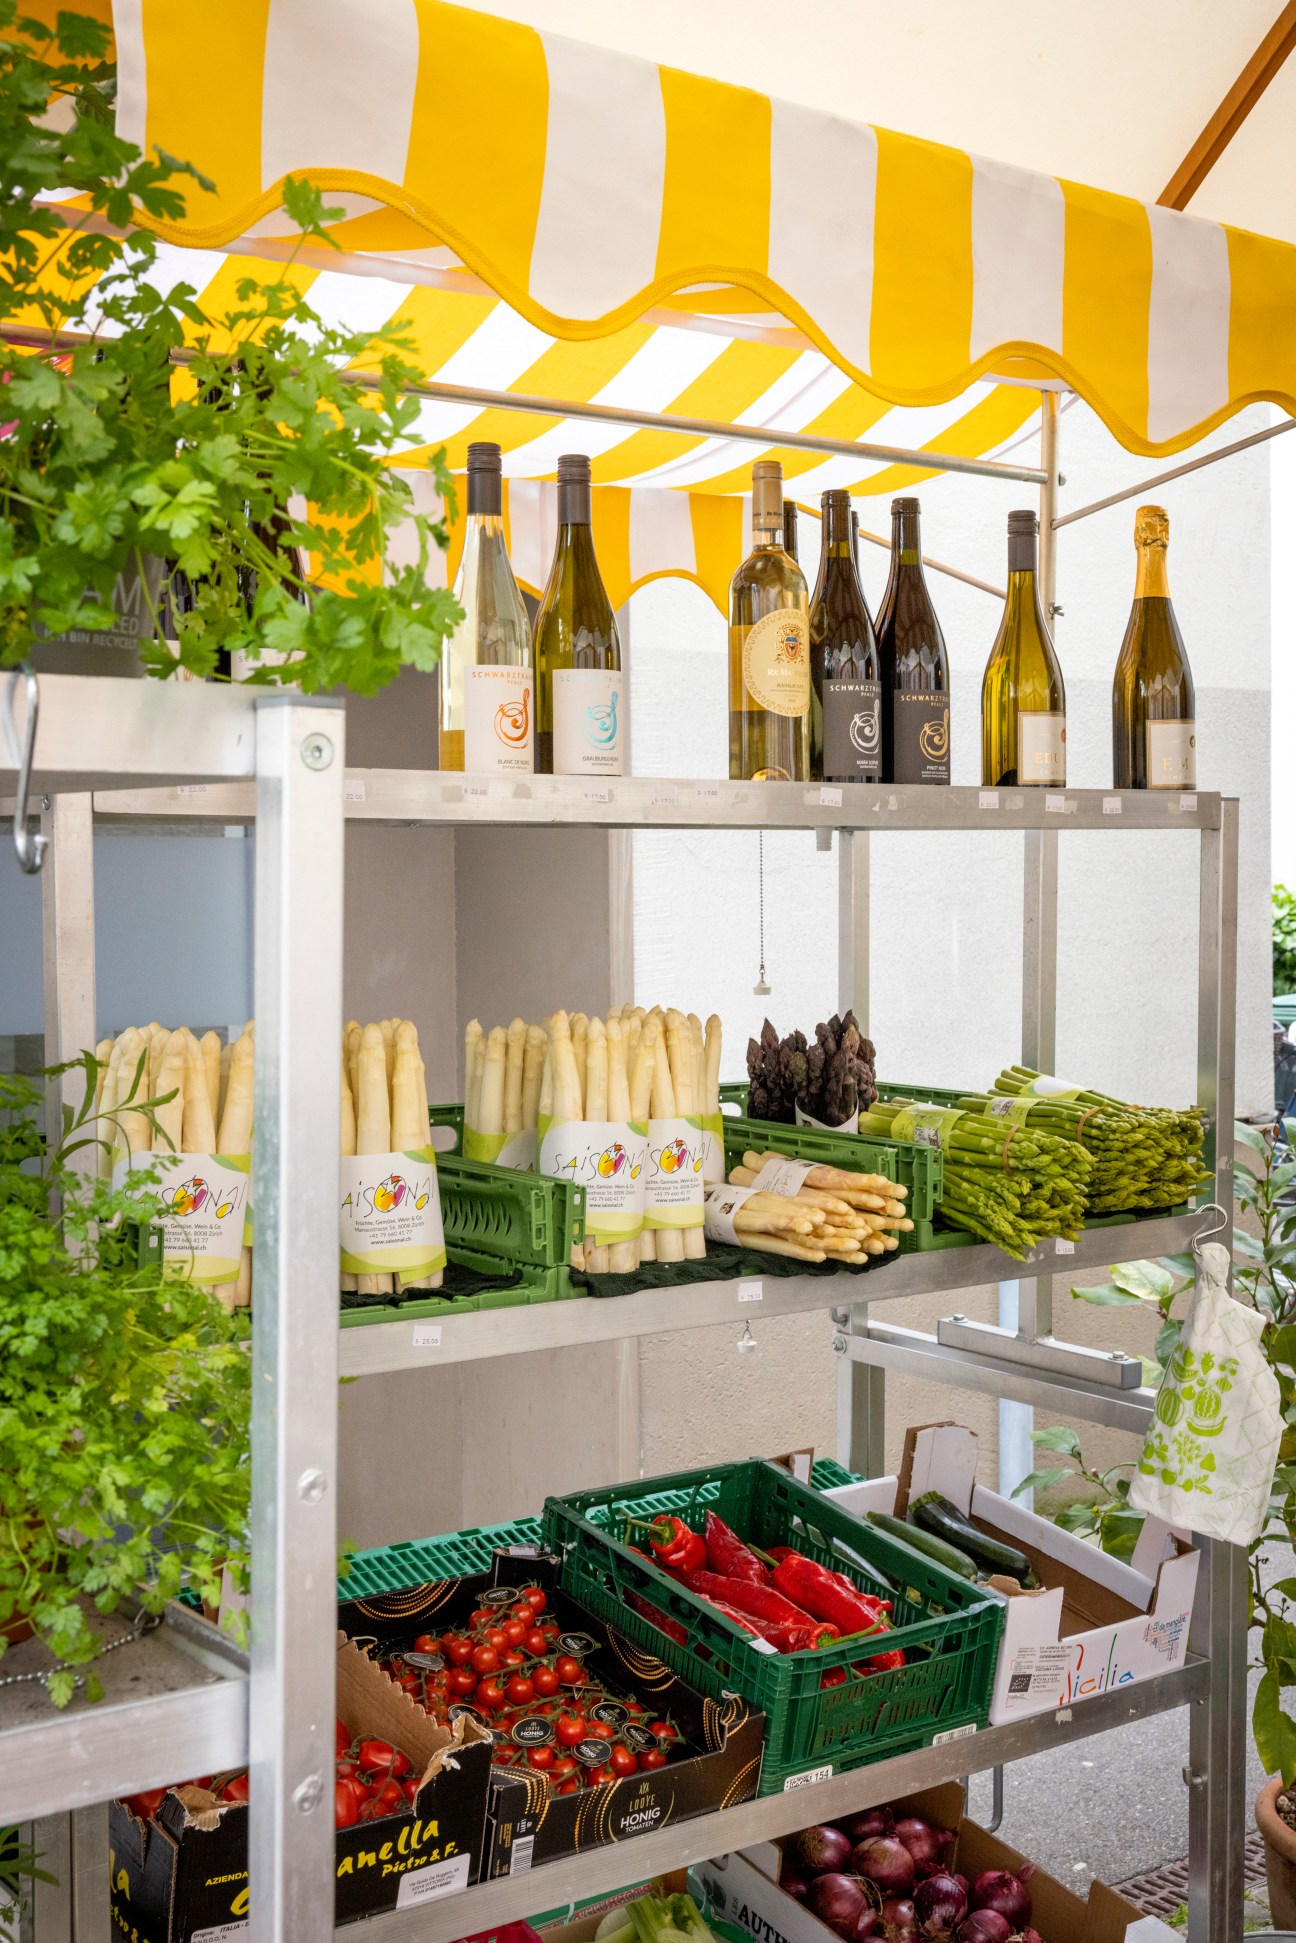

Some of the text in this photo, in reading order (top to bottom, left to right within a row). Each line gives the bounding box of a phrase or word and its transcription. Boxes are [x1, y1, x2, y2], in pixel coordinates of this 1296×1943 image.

[471, 788, 488, 796] 22.00
[580, 1744, 597, 1758] HONIG
[815, 1769, 829, 1781] 154
[620, 1806, 661, 1829] HONIG
[625, 1820, 654, 1833] TOMATEN
[381, 1856, 428, 1877] Pietro
[429, 1848, 440, 1861] &
[205, 1871, 249, 1887] AZIENDA
[219, 1923, 240, 1934] ITALIA
